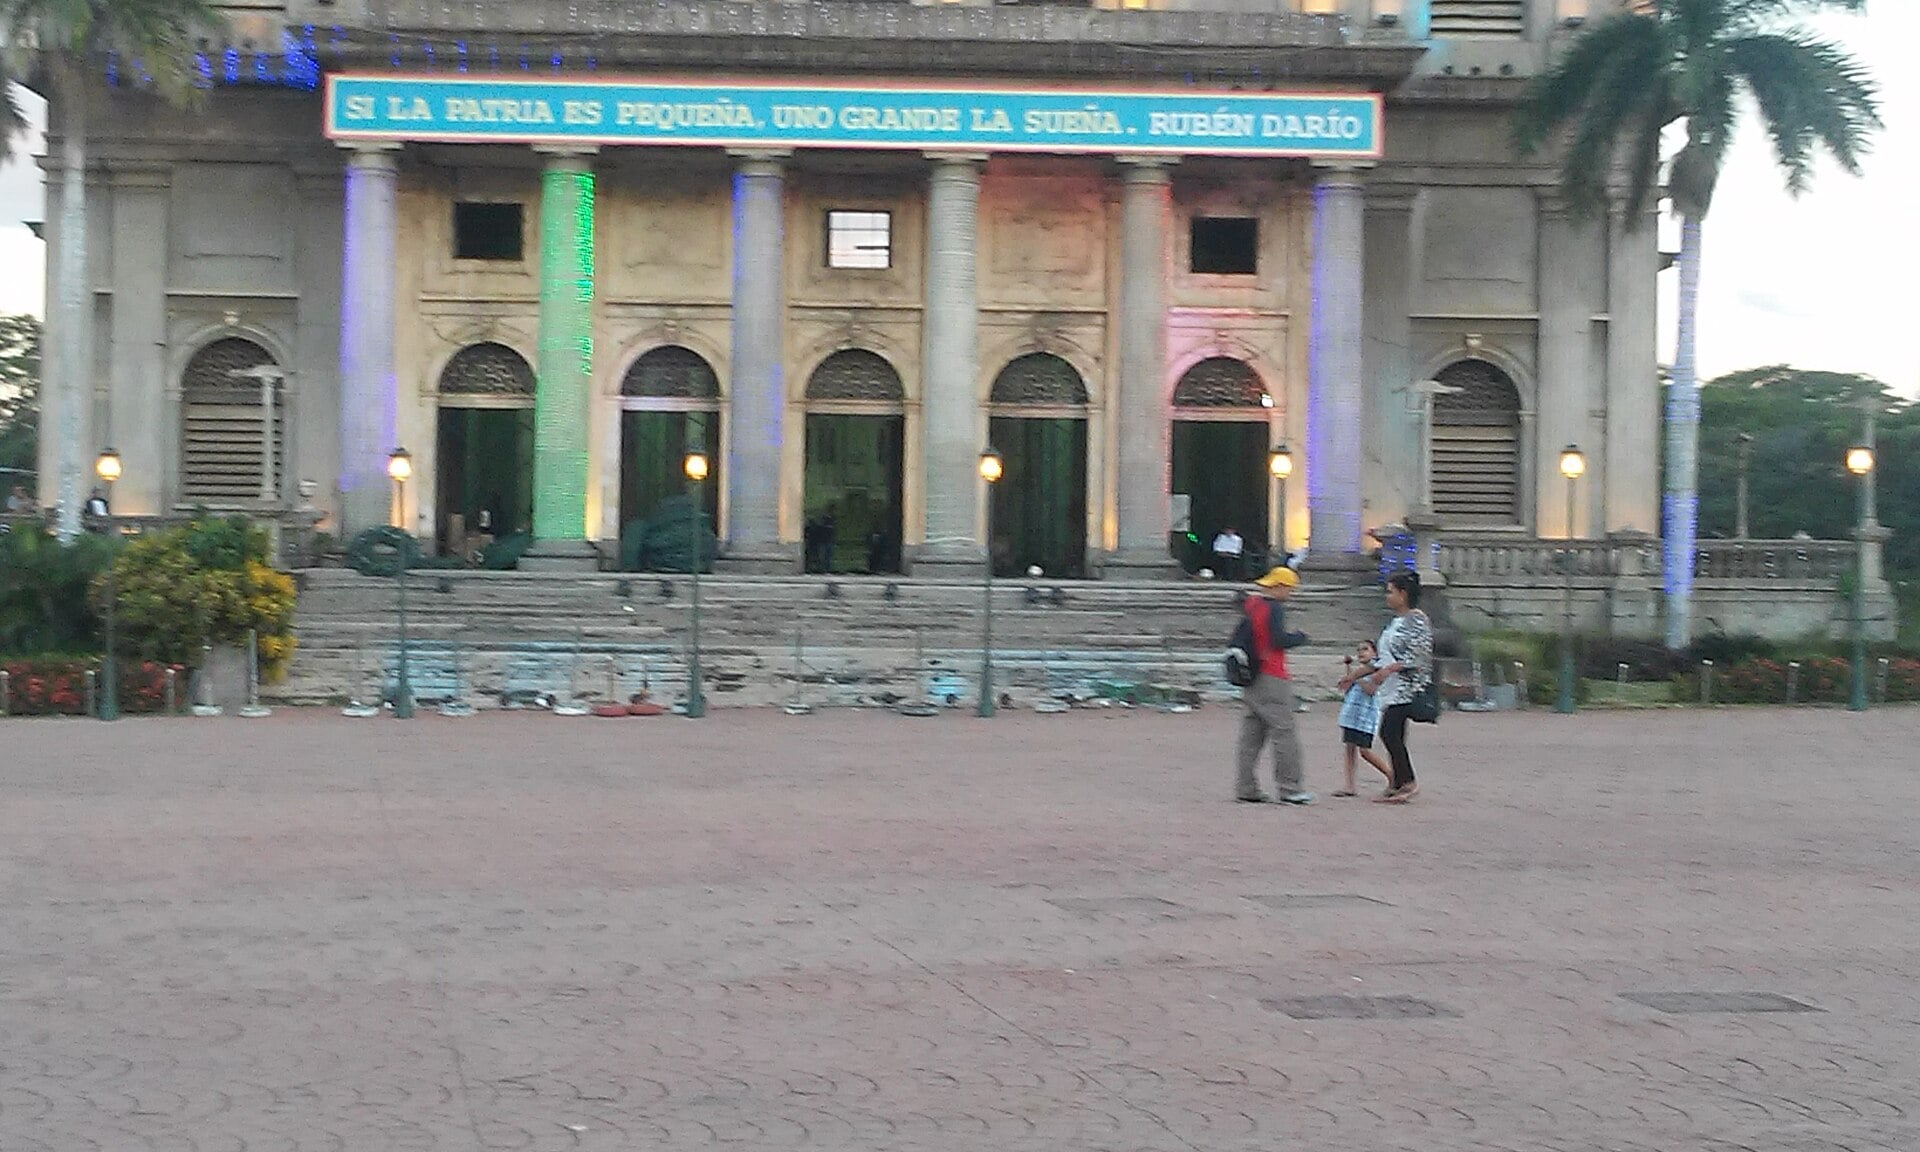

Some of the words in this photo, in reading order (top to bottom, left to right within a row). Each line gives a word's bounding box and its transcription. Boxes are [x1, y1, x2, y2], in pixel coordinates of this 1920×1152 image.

[345, 96, 375, 120] SI
[386, 97, 432, 121] LA
[445, 98, 555, 124] PATRIA
[562, 101, 602, 125] ES
[615, 96, 766, 131] PEQUEÑA,
[771, 105, 834, 130] UNO
[837, 106, 961, 132] GRANDE
[969, 108, 1014, 132] LA
[1149, 106, 1256, 138] RUBÉN
[1261, 108, 1364, 140] DARÍO
